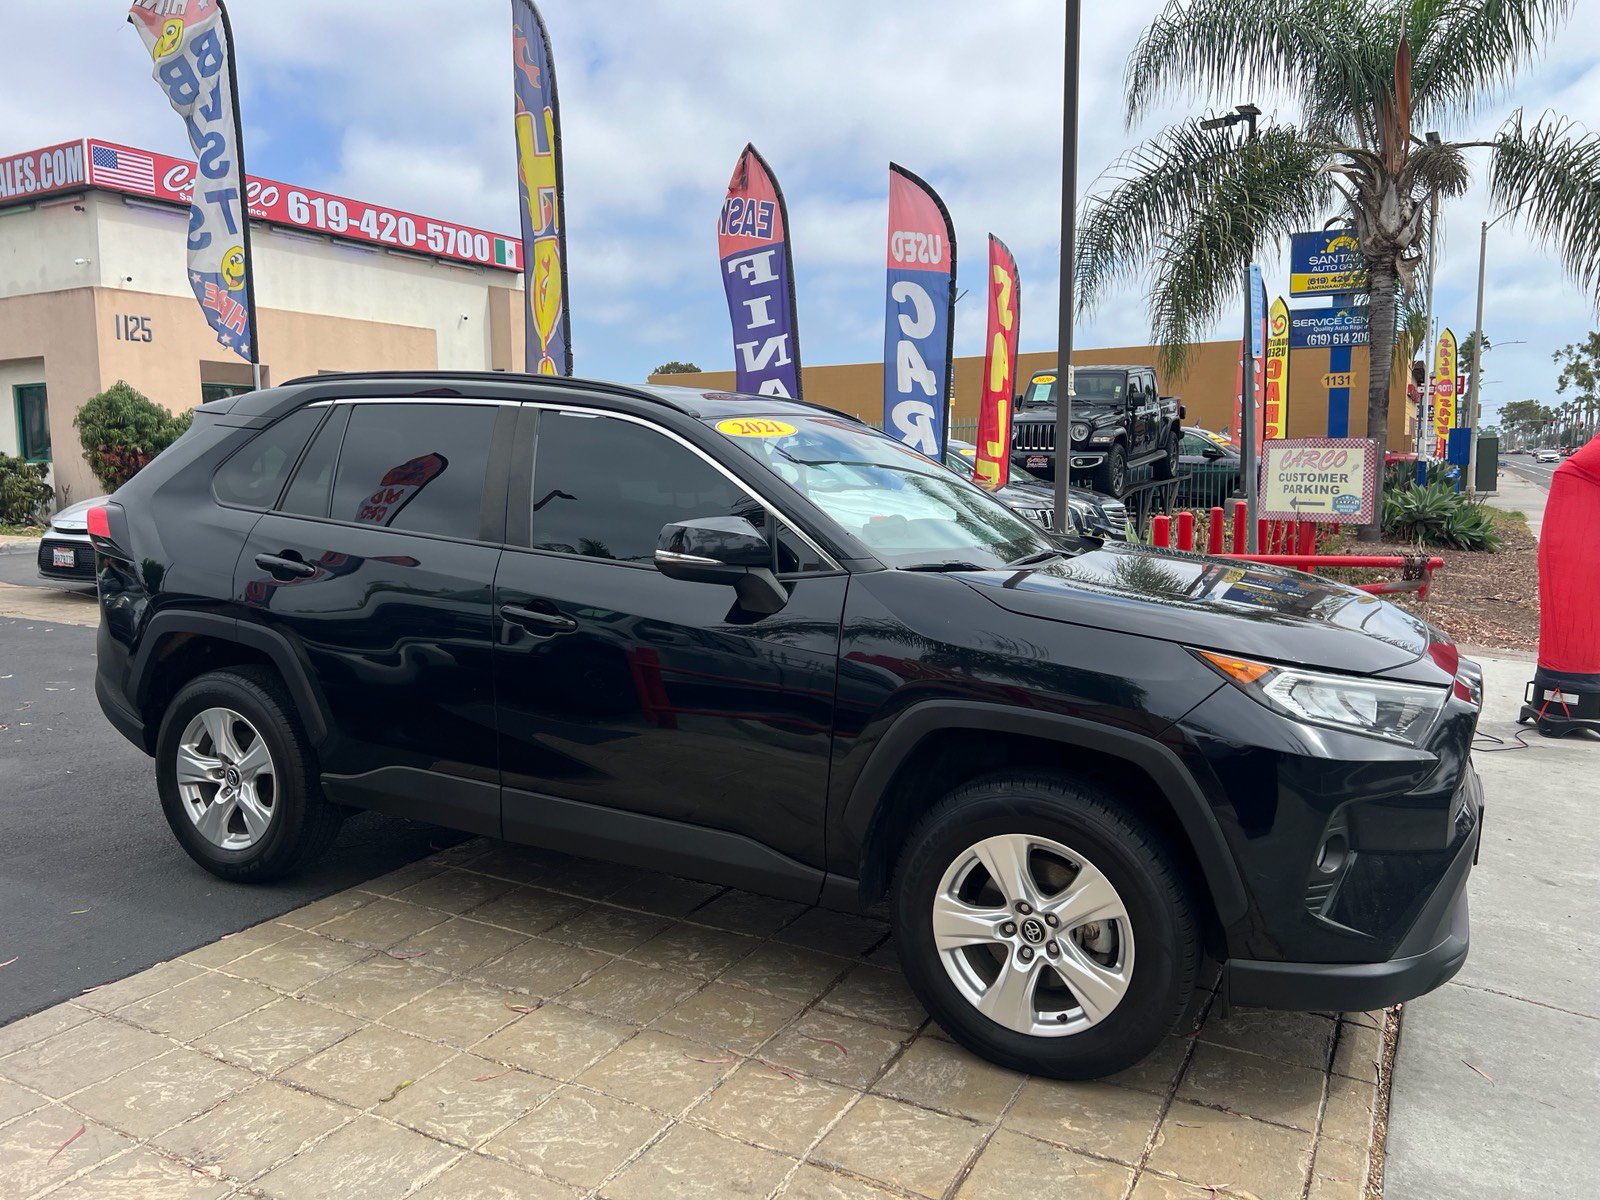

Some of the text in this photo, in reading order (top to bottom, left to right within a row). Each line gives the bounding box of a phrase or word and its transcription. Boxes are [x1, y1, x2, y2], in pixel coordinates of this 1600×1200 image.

[286, 190, 490, 262] 619-420-5700
[1311, 264, 1338, 273] AUTO
[1307, 276, 1329, 286] (619)
[1292, 315, 1369, 328] SERVICE CEN
[115, 313, 153, 343] 1125
[1312, 325, 1334, 333] Quality
[1306, 331, 1370, 346] (619) 614 200
[1324, 375, 1351, 386] 1131
[732, 421, 785, 435] 2021
[1279, 449, 1349, 471] CARCO
[1278, 472, 1349, 484] CUSTOMER
[1283, 484, 1341, 495] PARKING
